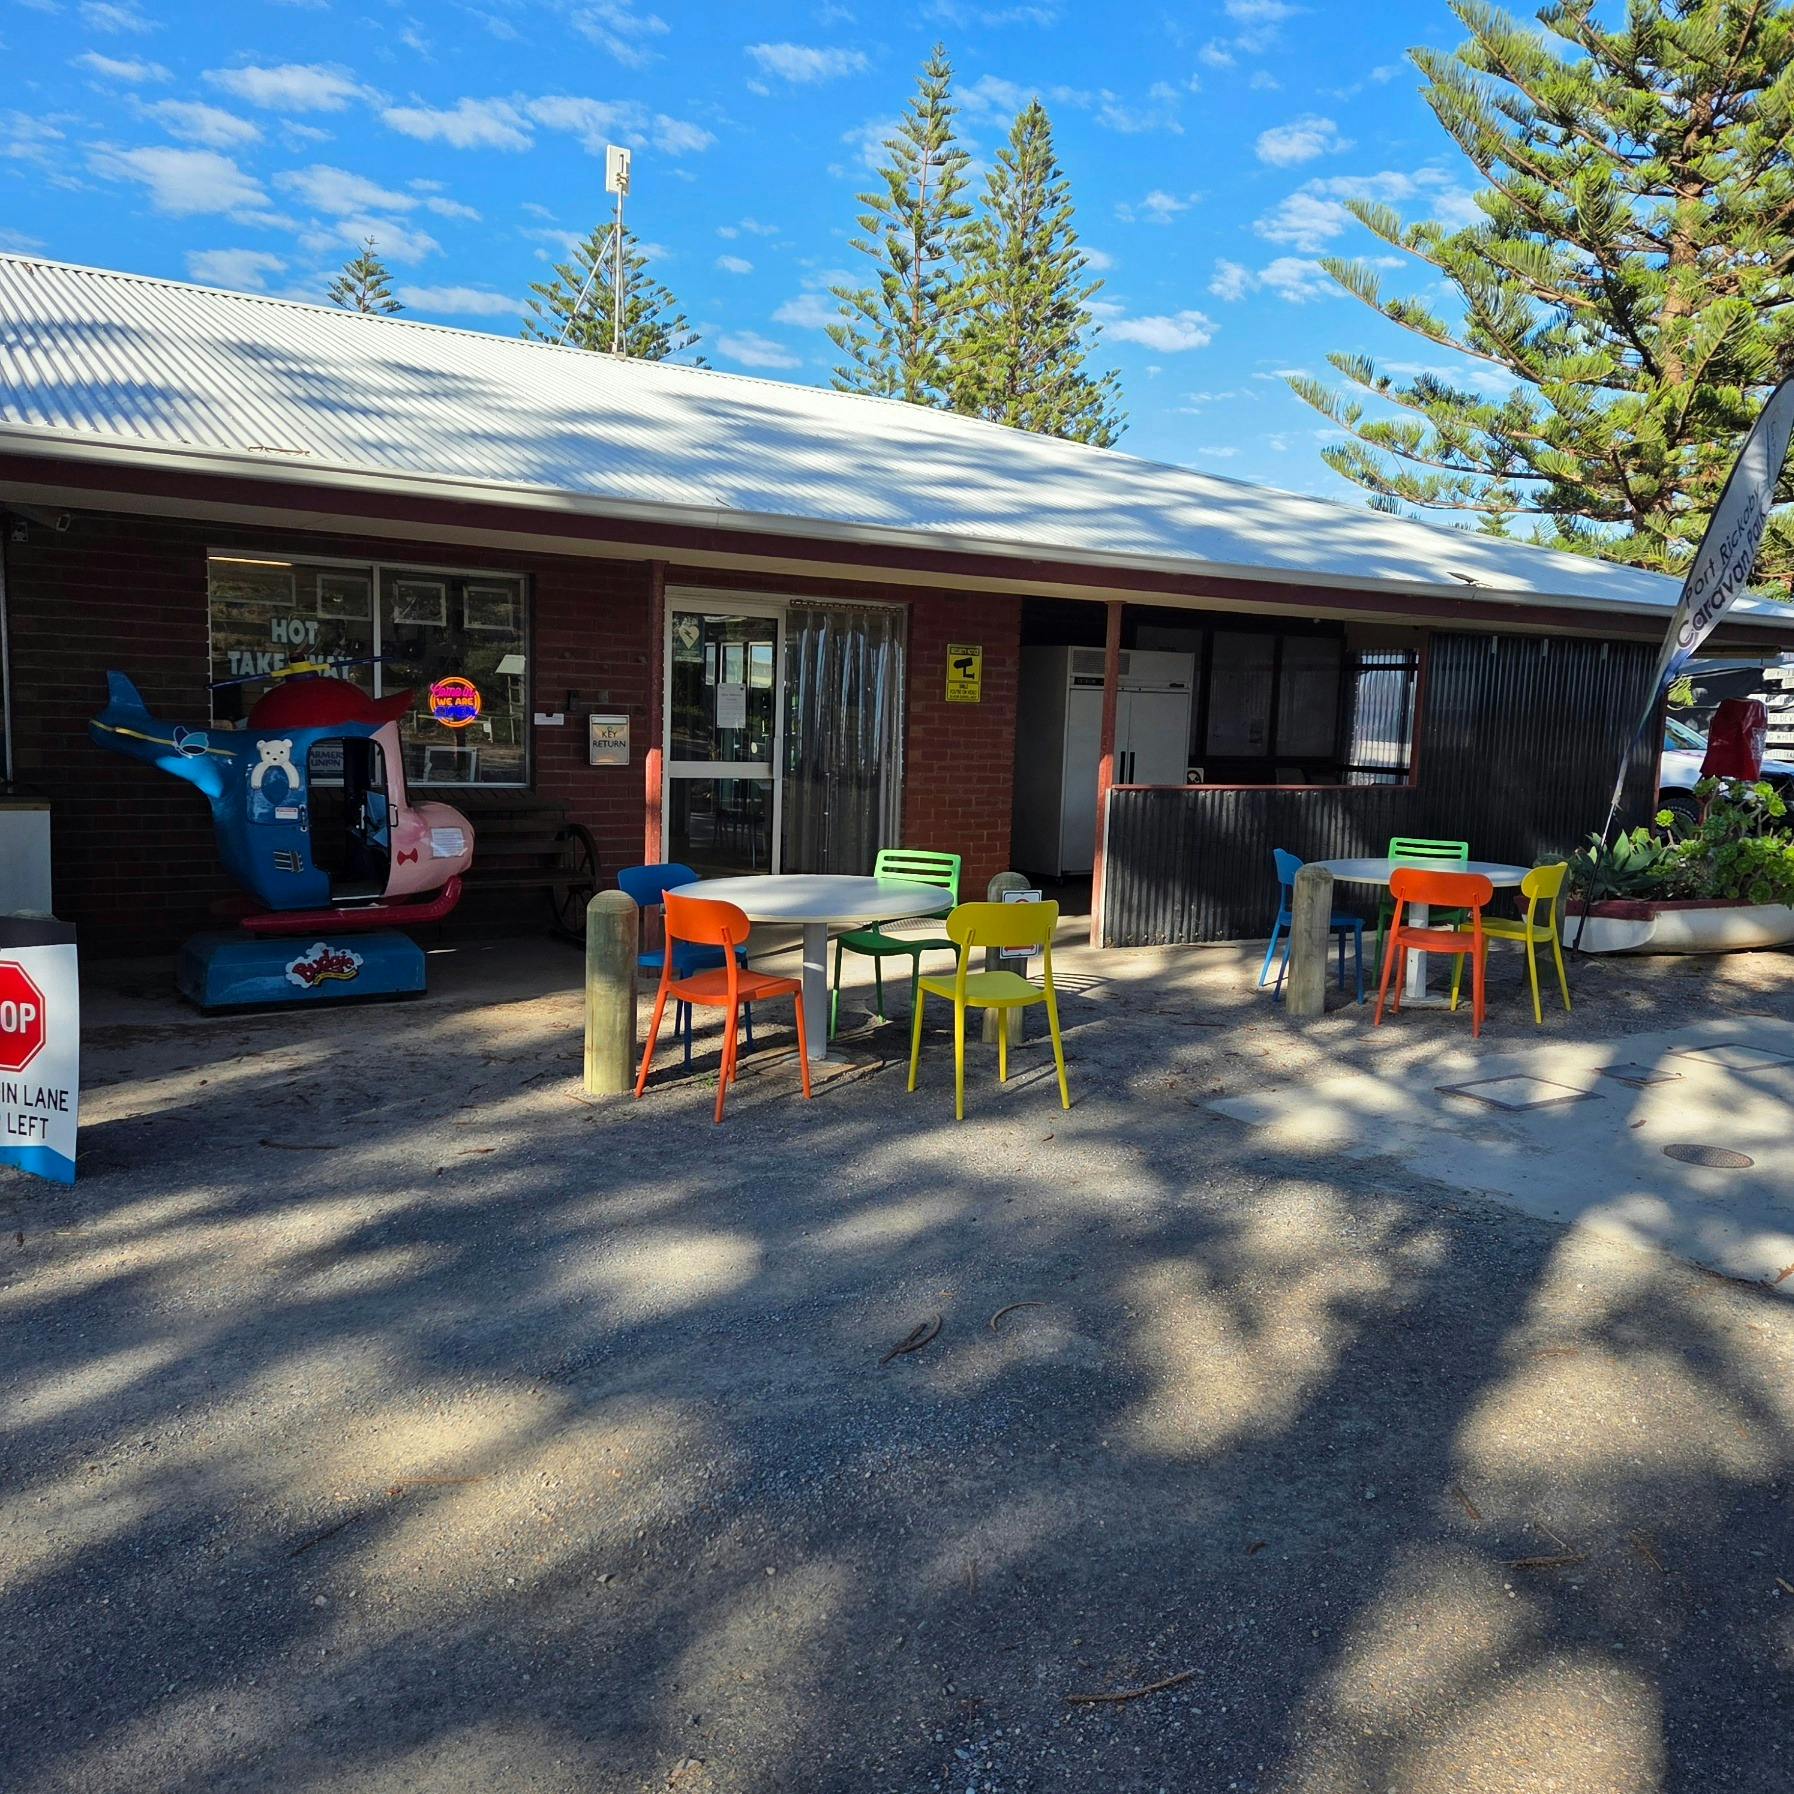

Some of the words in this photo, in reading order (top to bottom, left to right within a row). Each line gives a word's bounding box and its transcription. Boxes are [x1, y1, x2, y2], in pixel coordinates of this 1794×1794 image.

[1684, 558, 1717, 609] Port
[1719, 481, 1761, 568] Rickaby
[1677, 548, 1751, 648] Caravan
[1746, 508, 1768, 555] Park
[271, 618, 318, 645] HOT
[227, 651, 353, 680] TAKEWAY
[436, 697, 453, 706] WE
[455, 697, 474, 706] ARE
[592, 740, 626, 748] RETURN
[601, 729, 617, 738] KEY
[310, 750, 344, 760] ARMERS
[311, 759, 340, 767] UNION
[1, 1000, 36, 1034] OP
[24, 1084, 69, 1112] LANE
[7, 1112, 49, 1139] LEFT
